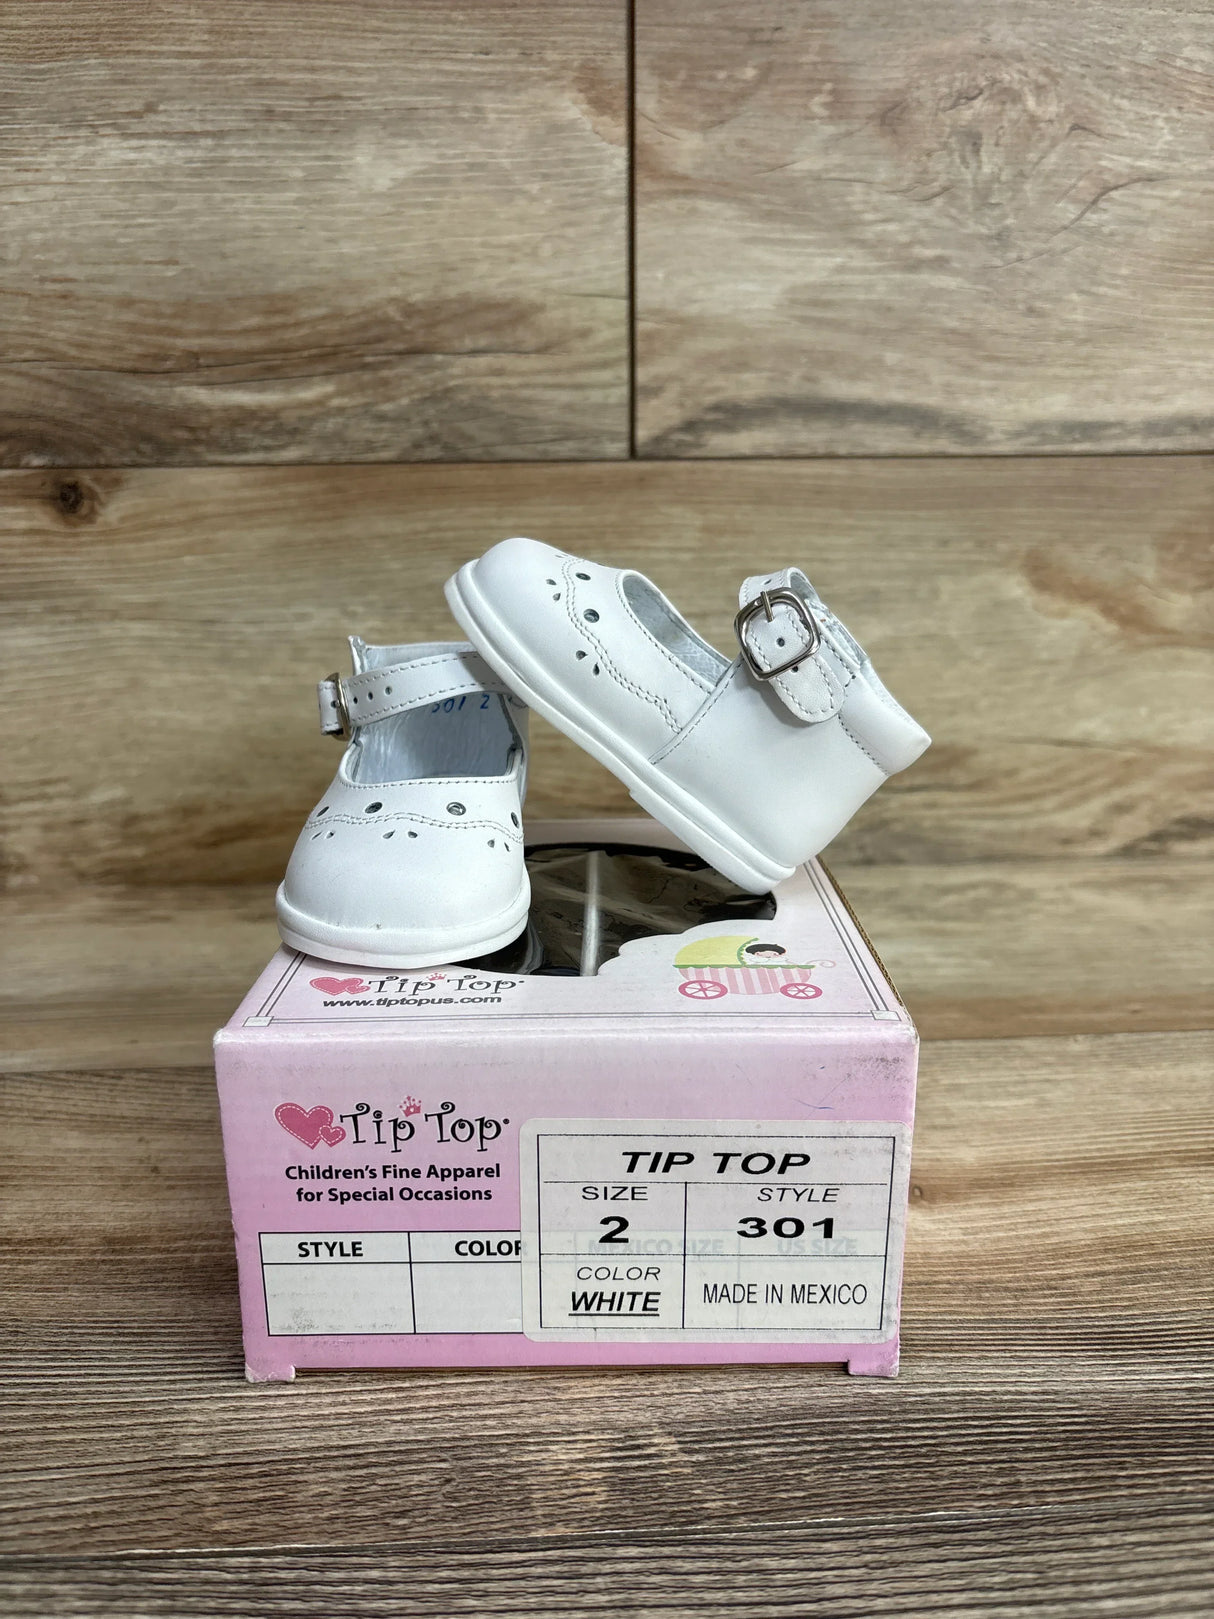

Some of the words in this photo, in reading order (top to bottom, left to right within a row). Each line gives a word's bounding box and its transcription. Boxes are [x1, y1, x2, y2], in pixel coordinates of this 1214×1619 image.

[480, 694, 490, 709] 2
[369, 975, 436, 997] Tip
[447, 974, 517, 995] Top
[323, 995, 502, 1008] www.tiptopus.com
[340, 1102, 415, 1153] Tip
[425, 1101, 502, 1152] Top
[285, 1165, 378, 1181] Children's
[382, 1165, 422, 1180] Fine
[426, 1163, 501, 1182] Apparel
[622, 1151, 694, 1173] TIP
[712, 1153, 811, 1175] TOP
[296, 1188, 324, 1203] for
[328, 1188, 395, 1205] Special
[399, 1186, 492, 1202] Occasions
[582, 1186, 648, 1201] SIZE
[757, 1187, 840, 1203] STYLE
[599, 1215, 630, 1244] 2
[736, 1216, 835, 1240] 301
[297, 1241, 364, 1258] STYLE
[576, 1266, 661, 1281] COLOR
[571, 1291, 661, 1312] WHITE
[703, 1283, 757, 1304] MADE
[765, 1284, 784, 1304] IN
[791, 1284, 868, 1305] MEXICO
